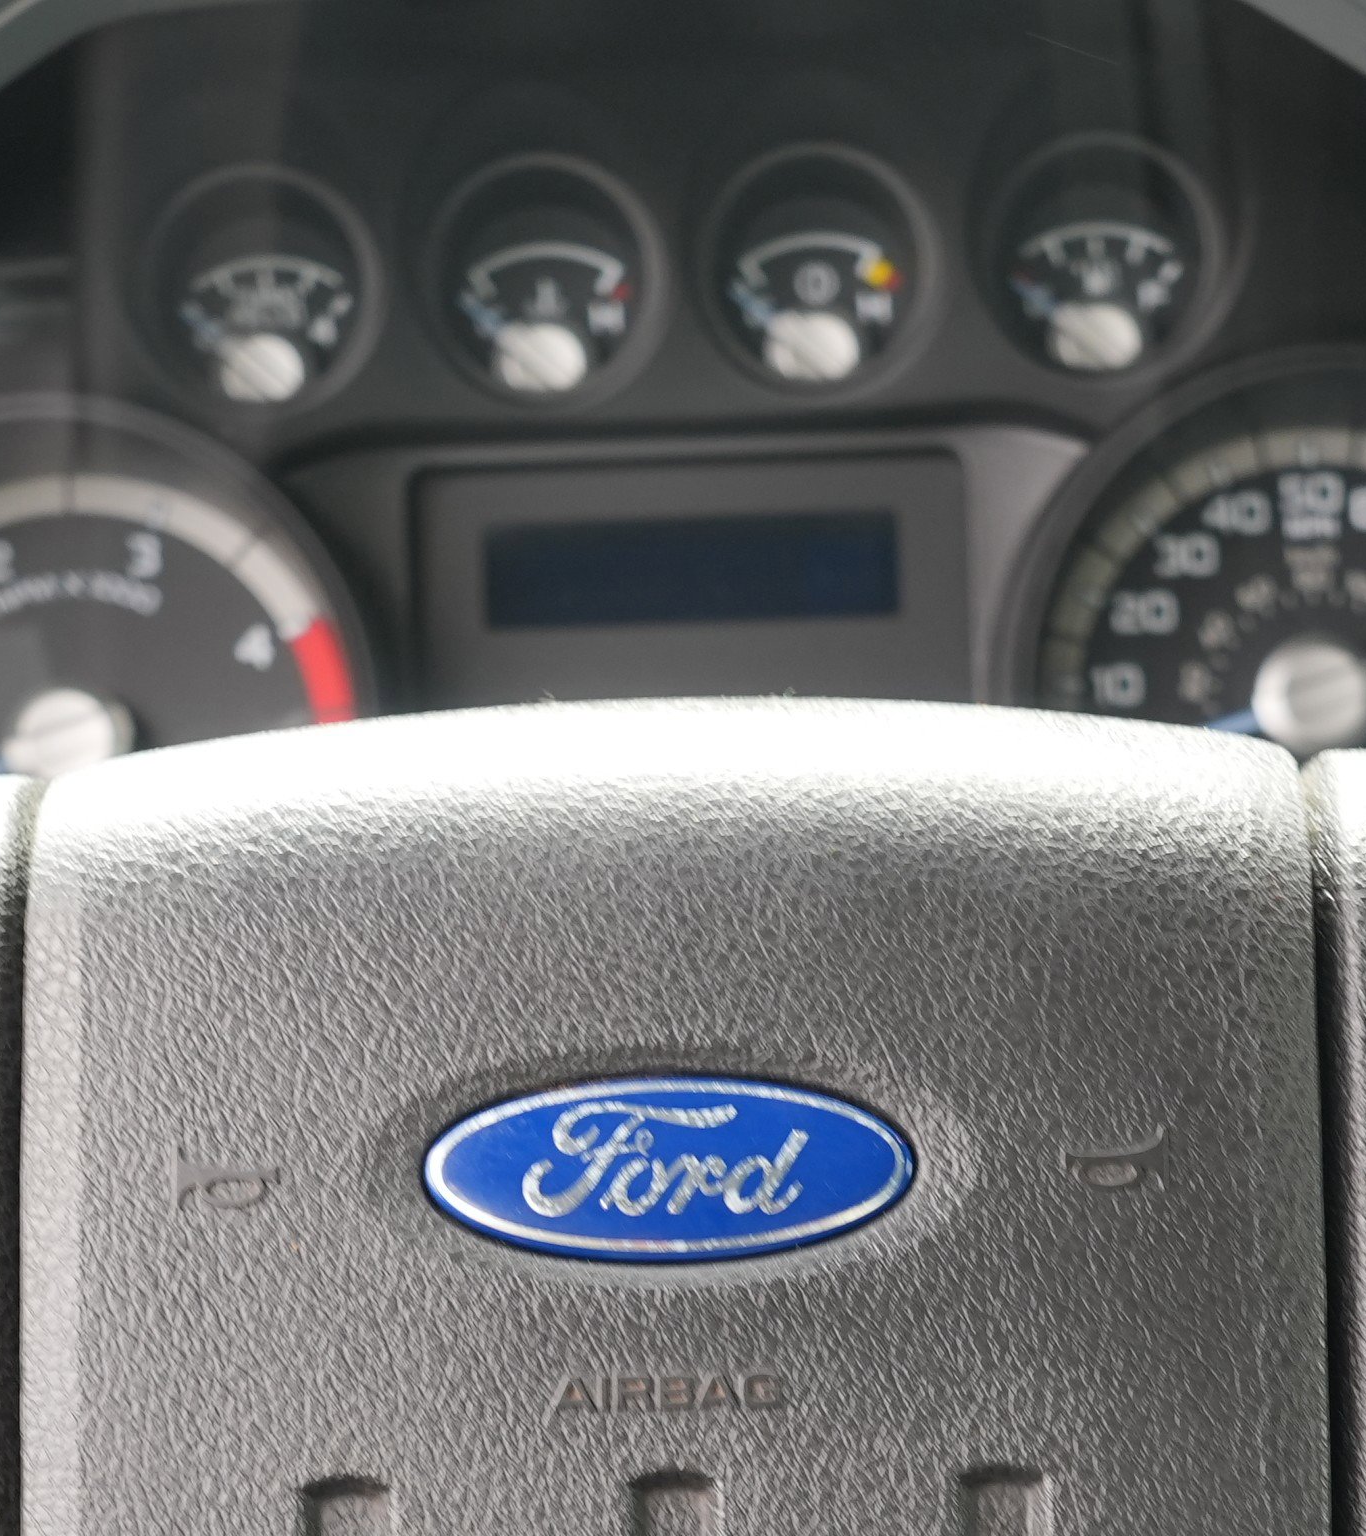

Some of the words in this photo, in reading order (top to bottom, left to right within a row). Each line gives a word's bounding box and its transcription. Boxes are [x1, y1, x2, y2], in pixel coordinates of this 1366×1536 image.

[126, 531, 164, 580] 3
[235, 621, 276, 671] 4
[522, 1101, 809, 1218] Ford
[543, 1372, 786, 1417] AIRBAG
